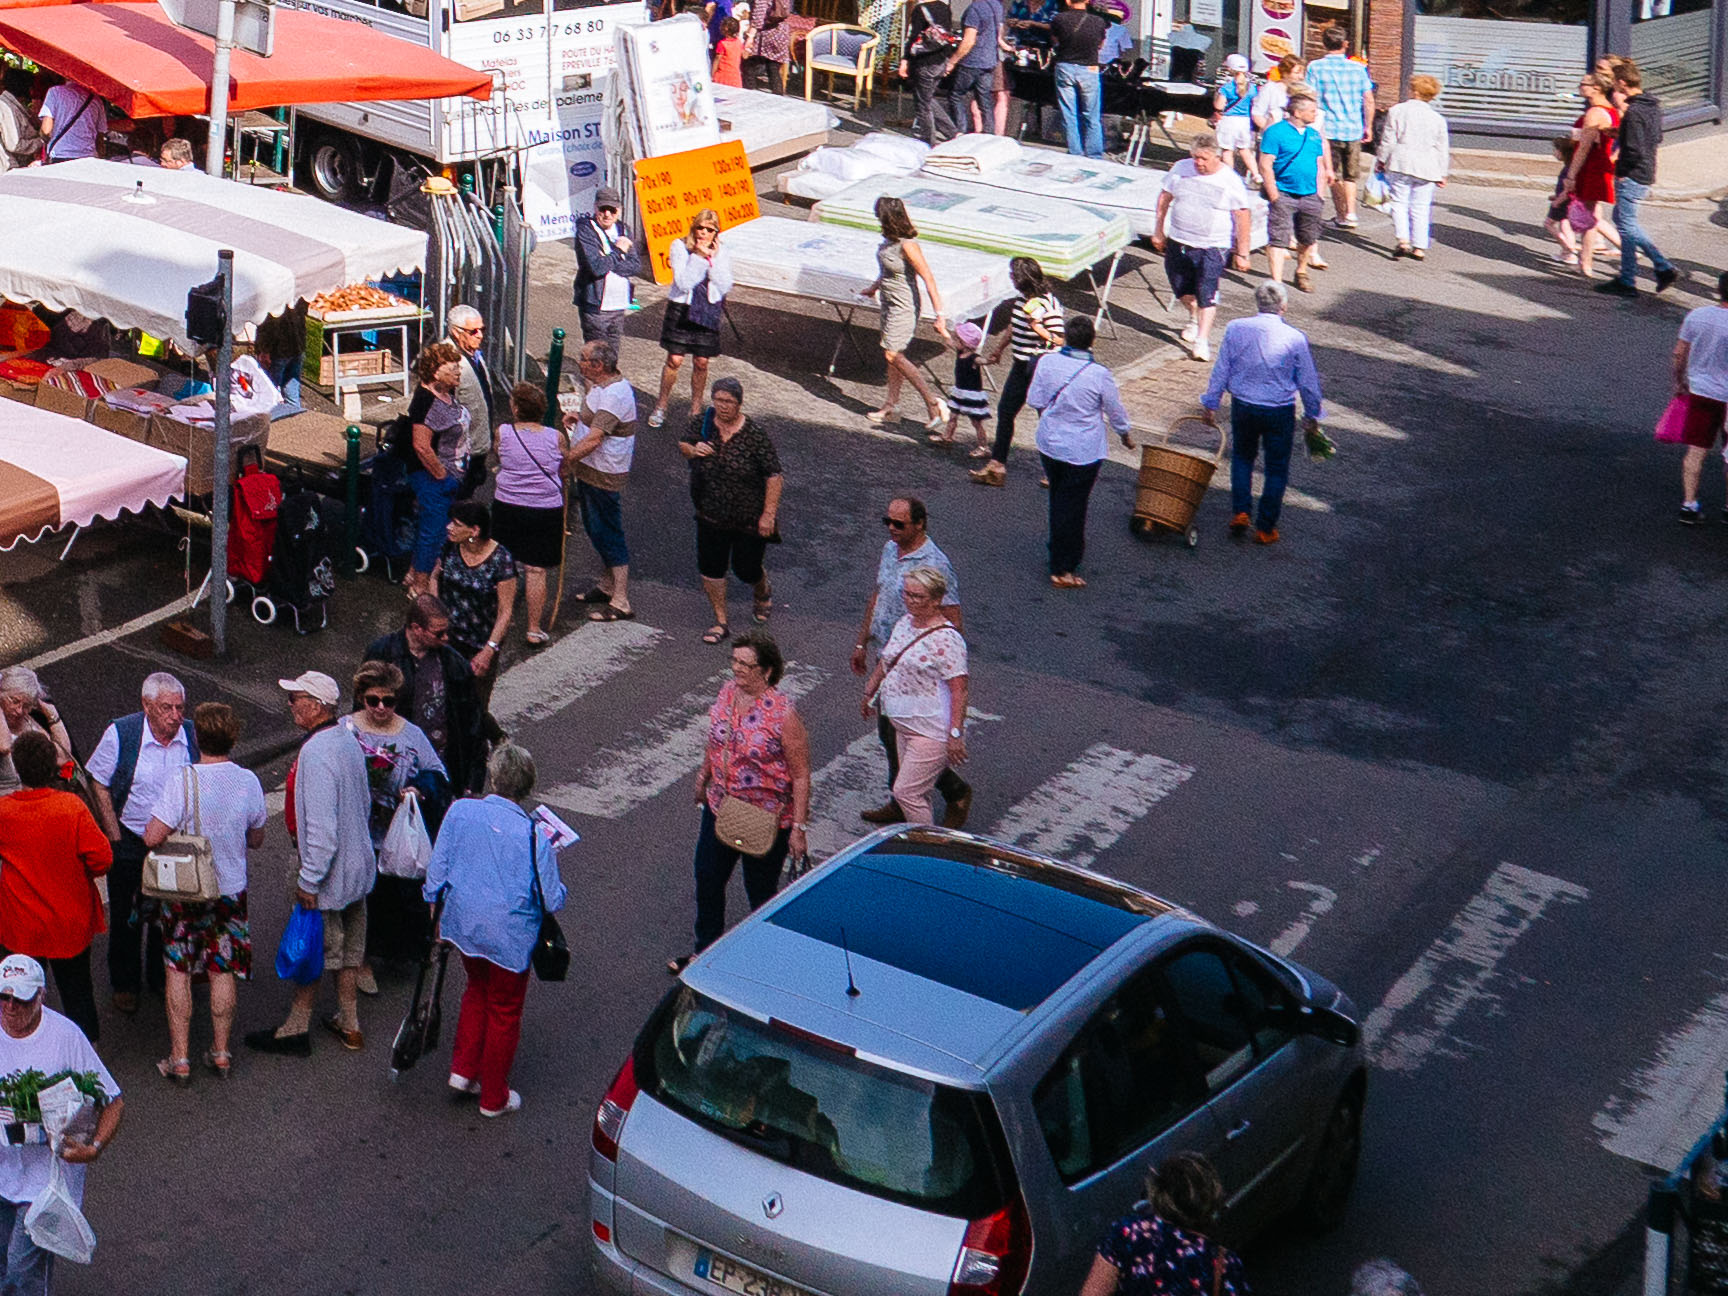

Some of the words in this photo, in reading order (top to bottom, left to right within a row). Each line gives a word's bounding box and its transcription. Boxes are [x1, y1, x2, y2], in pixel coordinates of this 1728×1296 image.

[493, 29, 511, 44] 06
[516, 27, 534, 42] 33
[564, 21, 582, 36] 68
[586, 18, 604, 33] 80
[556, 91, 603, 107] paieme
[528, 127, 581, 144] Maison
[584, 122, 601, 138] ST
[712, 155, 745, 176] 130x190
